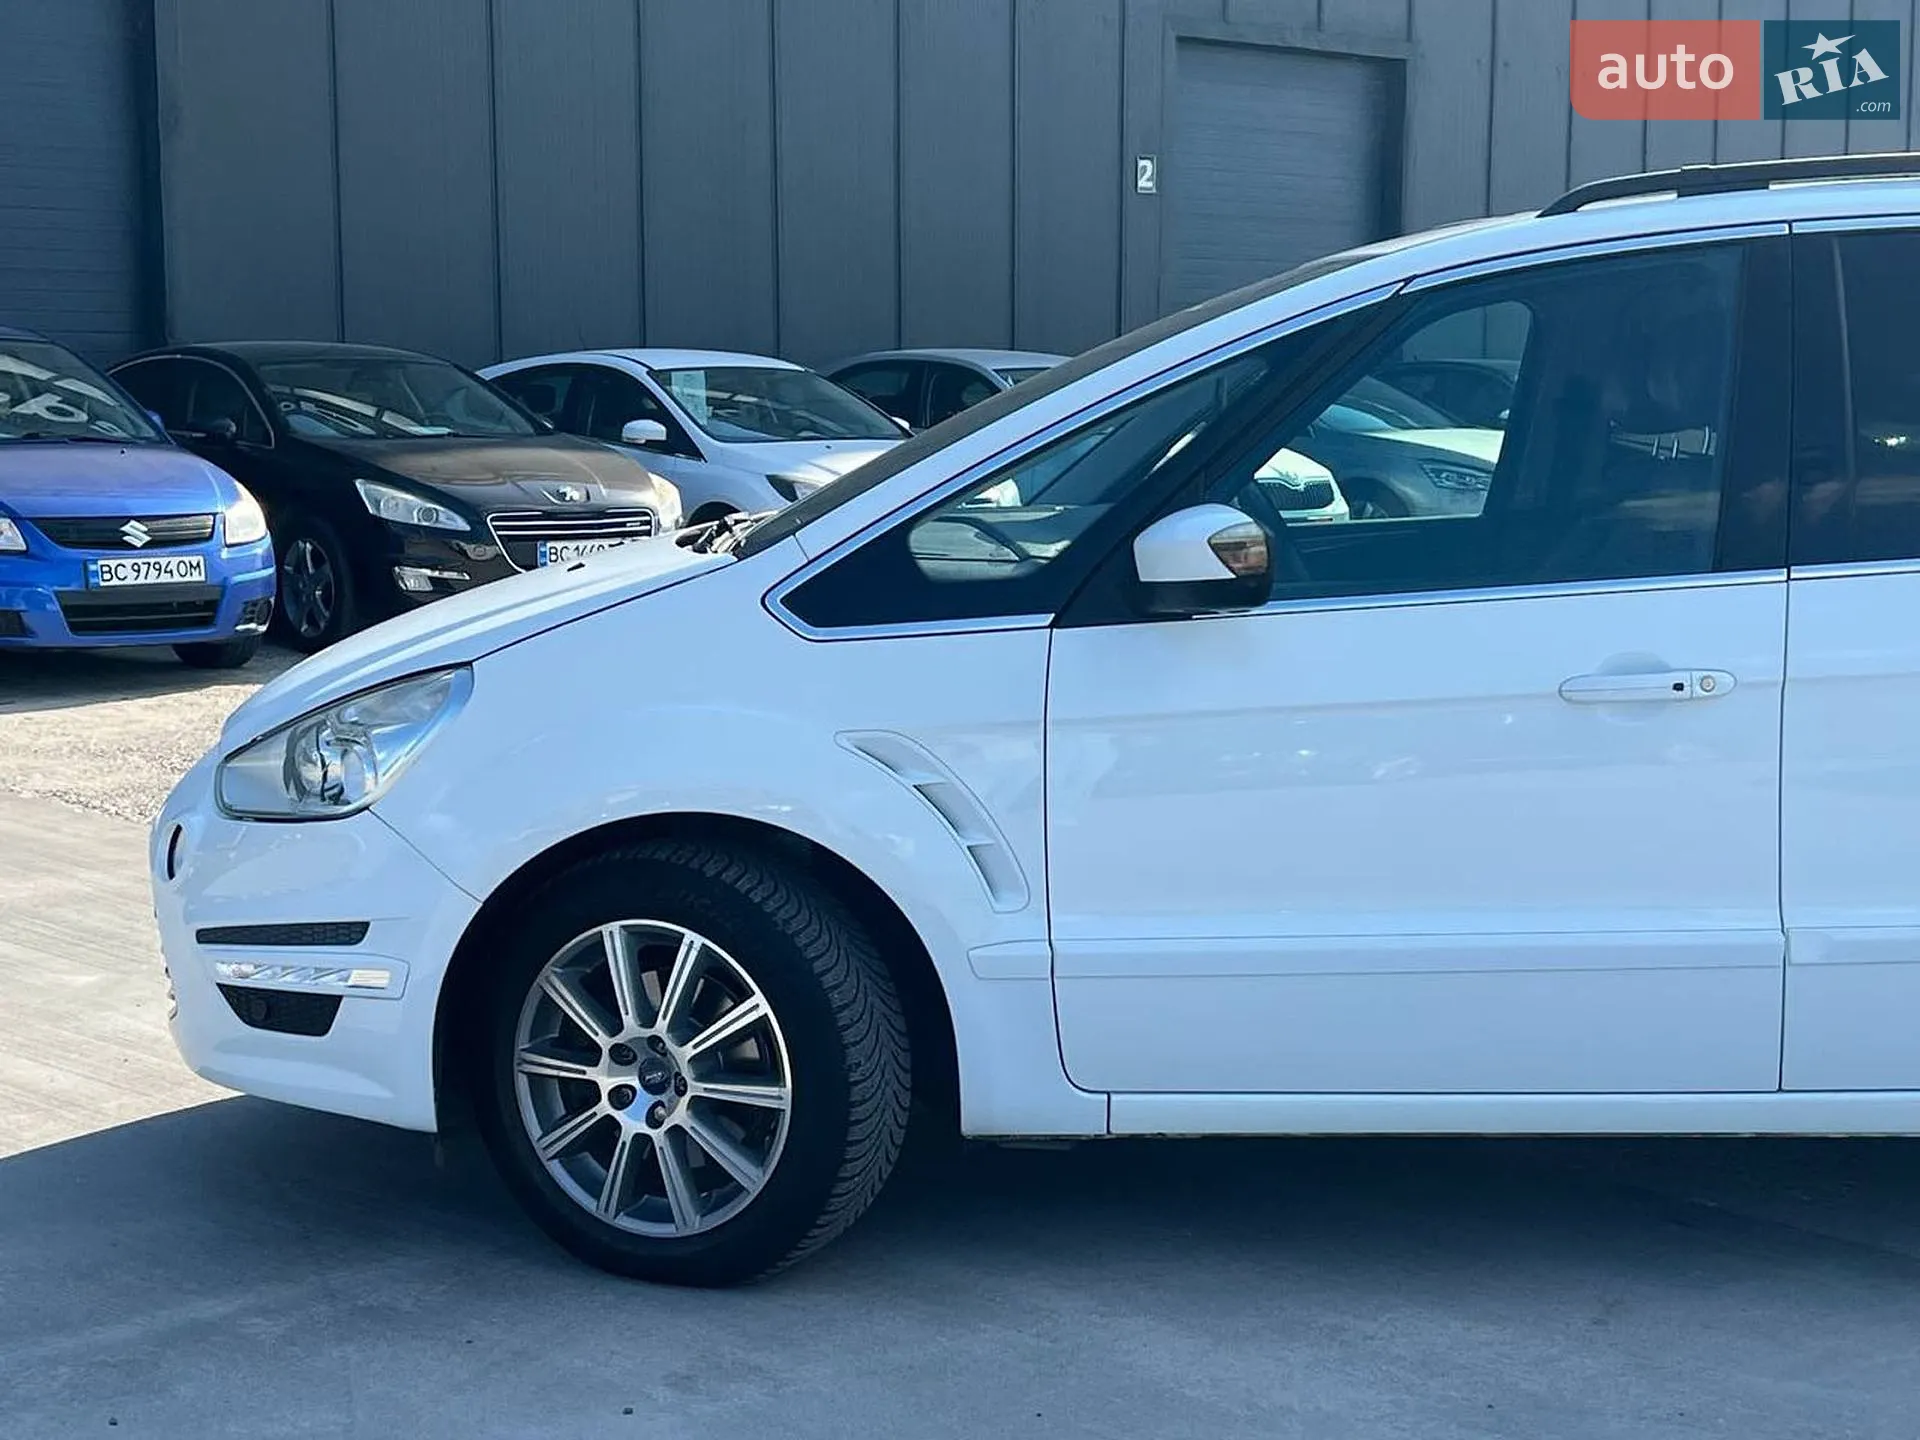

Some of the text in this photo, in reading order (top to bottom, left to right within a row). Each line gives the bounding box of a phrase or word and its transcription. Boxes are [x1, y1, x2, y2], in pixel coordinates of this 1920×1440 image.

[1138, 159, 1153, 187] 2
[100, 560, 202, 582] BC 9794 OM
